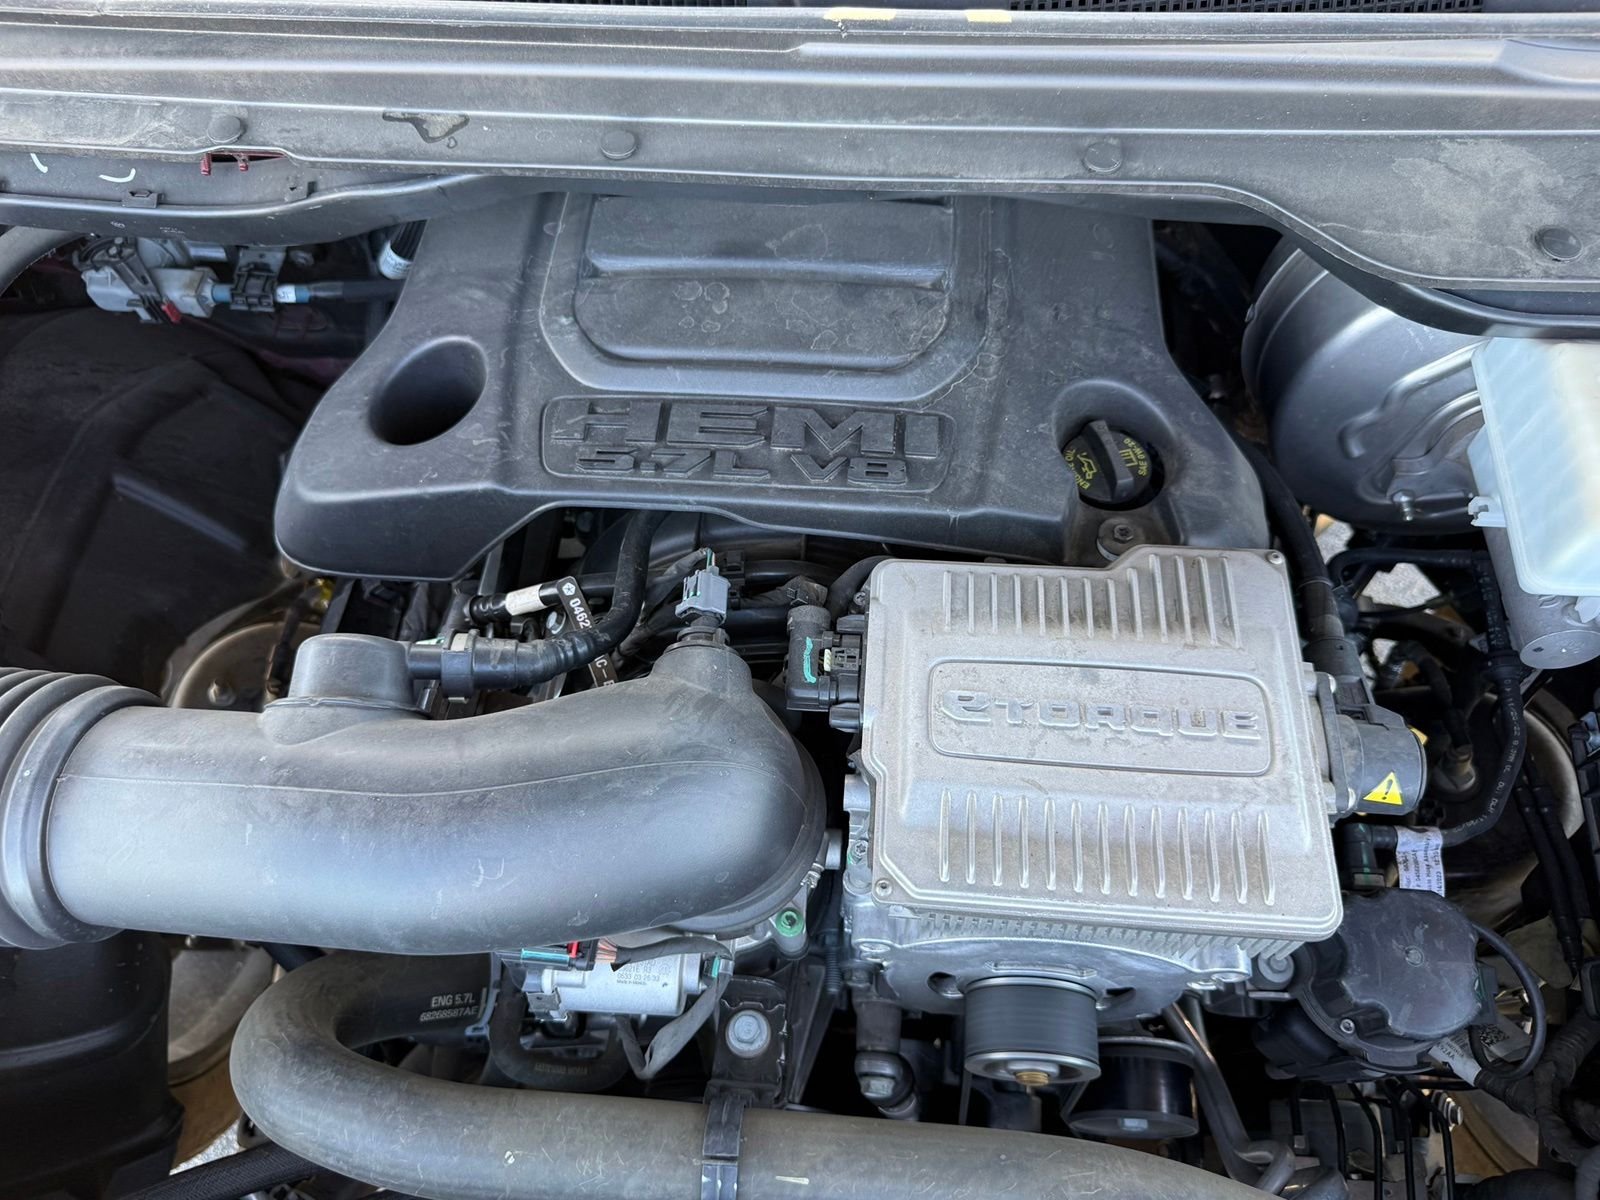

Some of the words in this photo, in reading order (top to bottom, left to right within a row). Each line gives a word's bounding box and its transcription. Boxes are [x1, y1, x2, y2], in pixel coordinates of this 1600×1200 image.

[551, 400, 940, 458] HEMI
[575, 446, 771, 480] 5.7L
[790, 453, 907, 485] V8
[1064, 448, 1076, 462] OIL
[568, 597, 593, 629] 0462
[431, 994, 454, 1008] ENG
[455, 992, 476, 1005] 5.7L
